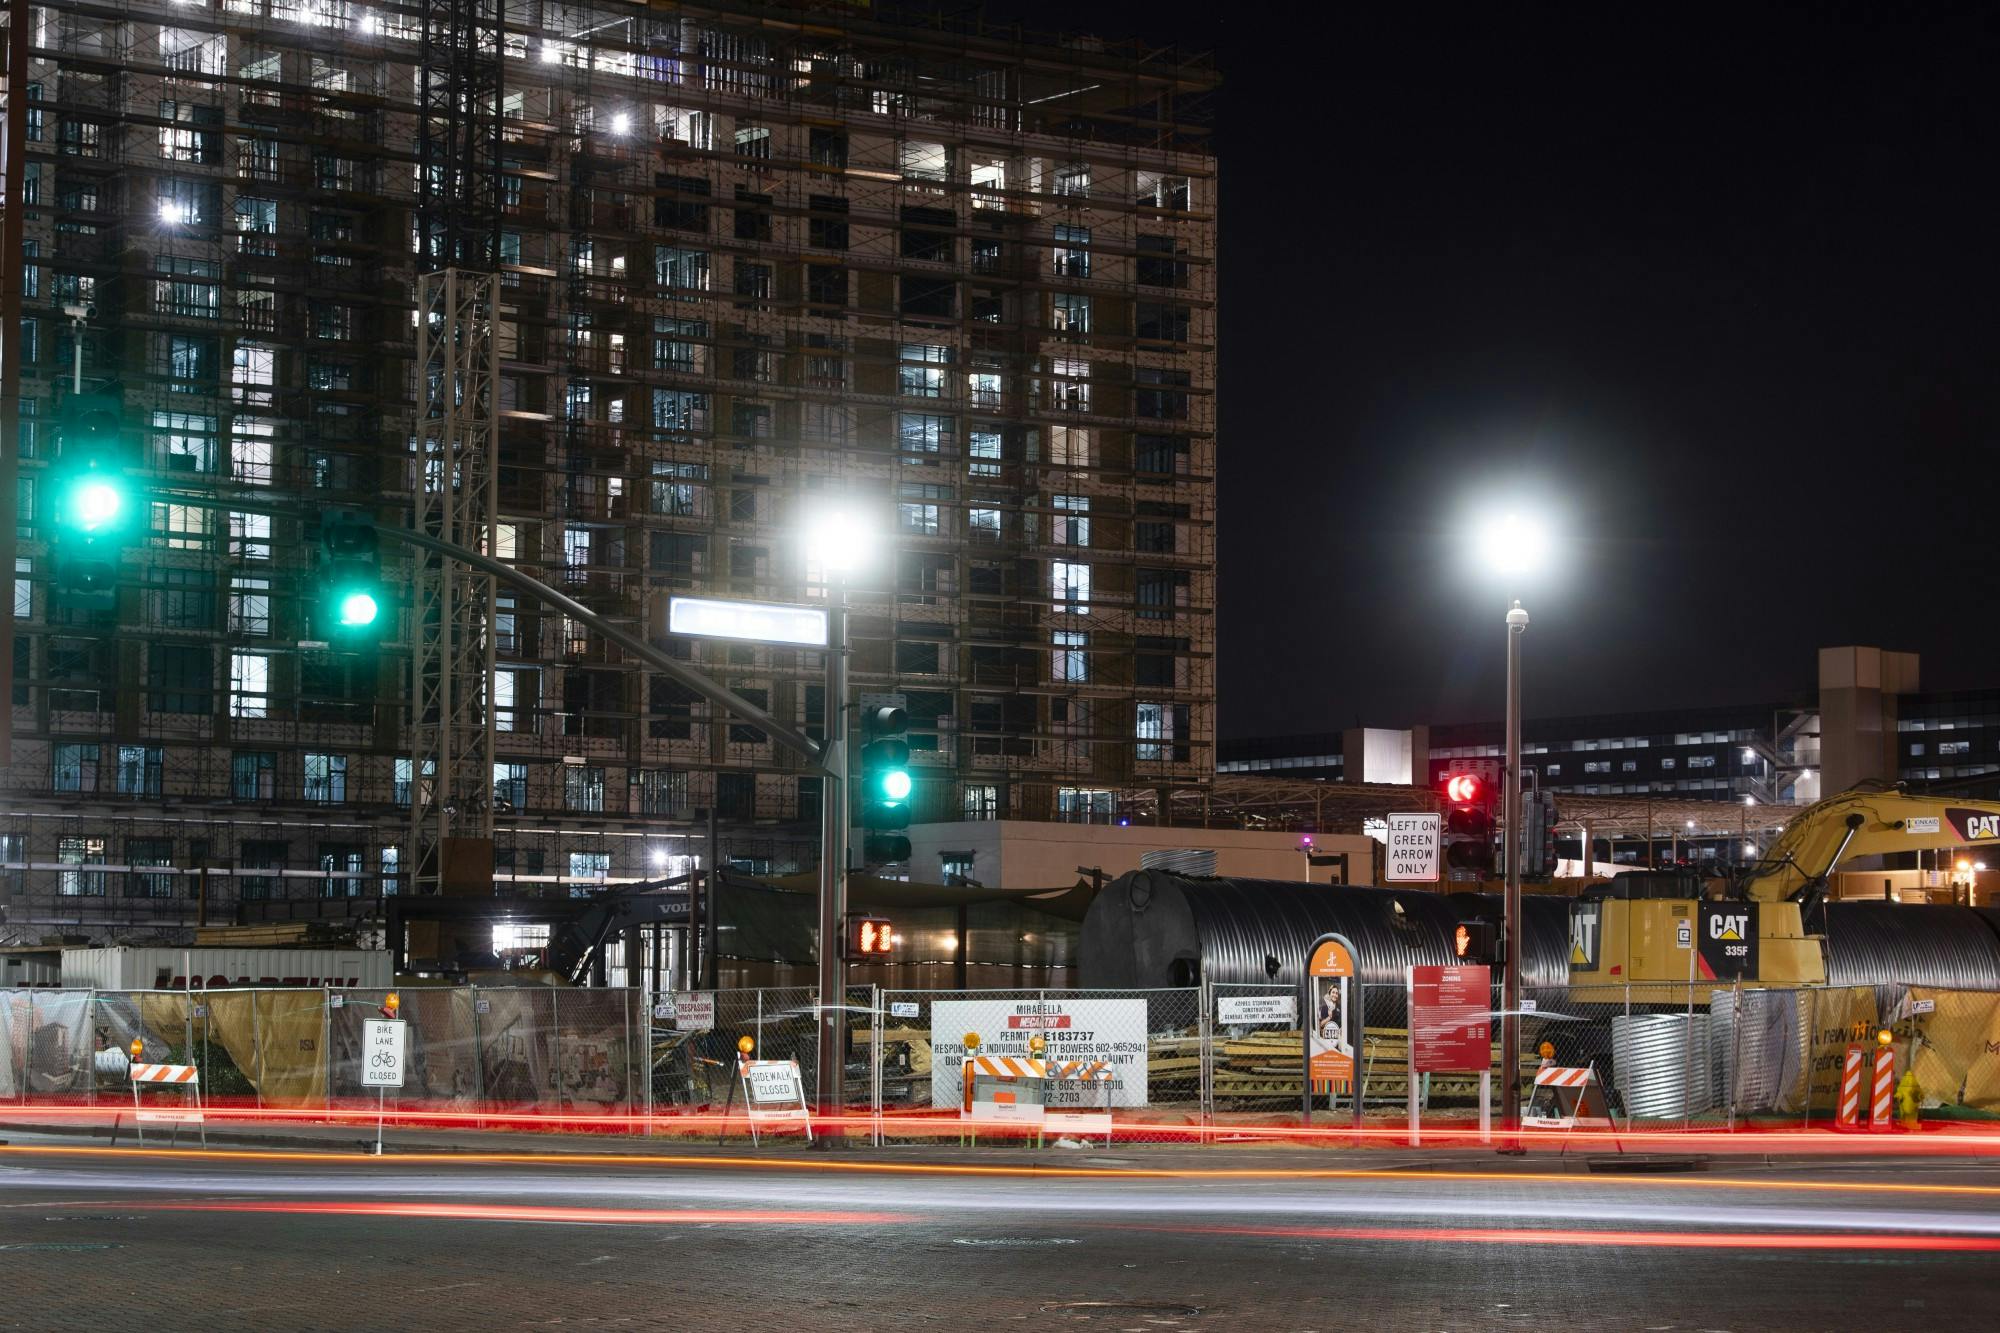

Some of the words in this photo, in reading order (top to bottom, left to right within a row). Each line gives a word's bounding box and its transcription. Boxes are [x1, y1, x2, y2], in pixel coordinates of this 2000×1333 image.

[1391, 821, 1418, 831] LEFT
[1421, 821, 1437, 831] ON
[1967, 815, 2000, 839] CAT
[1394, 835, 1432, 845] GREEN
[1392, 849, 1433, 860] ARROW
[1396, 863, 1428, 874] ONLY
[658, 902, 705, 914] VOL
[1710, 914, 1748, 940] CAT
[1570, 914, 1597, 964] AT
[1725, 945, 1748, 956] 335F
[677, 1002, 712, 1012] TRESPASSING
[1016, 1004, 1063, 1015] MIRABELLA
[1019, 1016, 1060, 1028] McCATHY
[376, 1026, 393, 1035] BIKE
[1000, 1031, 1030, 1041] PERMIT
[1043, 1031, 1095, 1041] E183737
[375, 1037, 394, 1046] LANE
[934, 1043, 984, 1054] RESPONE
[986, 1043, 1029, 1054] INDIVIDUAL:
[1060, 1043, 1094, 1054] BOWERS
[1095, 1042, 1146, 1054] 602-9652941
[1101, 1054, 1135, 1065] CUNTY
[369, 1071, 397, 1080] CLOSED
[752, 1071, 792, 1082] SIDEWALK
[760, 1085, 790, 1095] CLOSED
